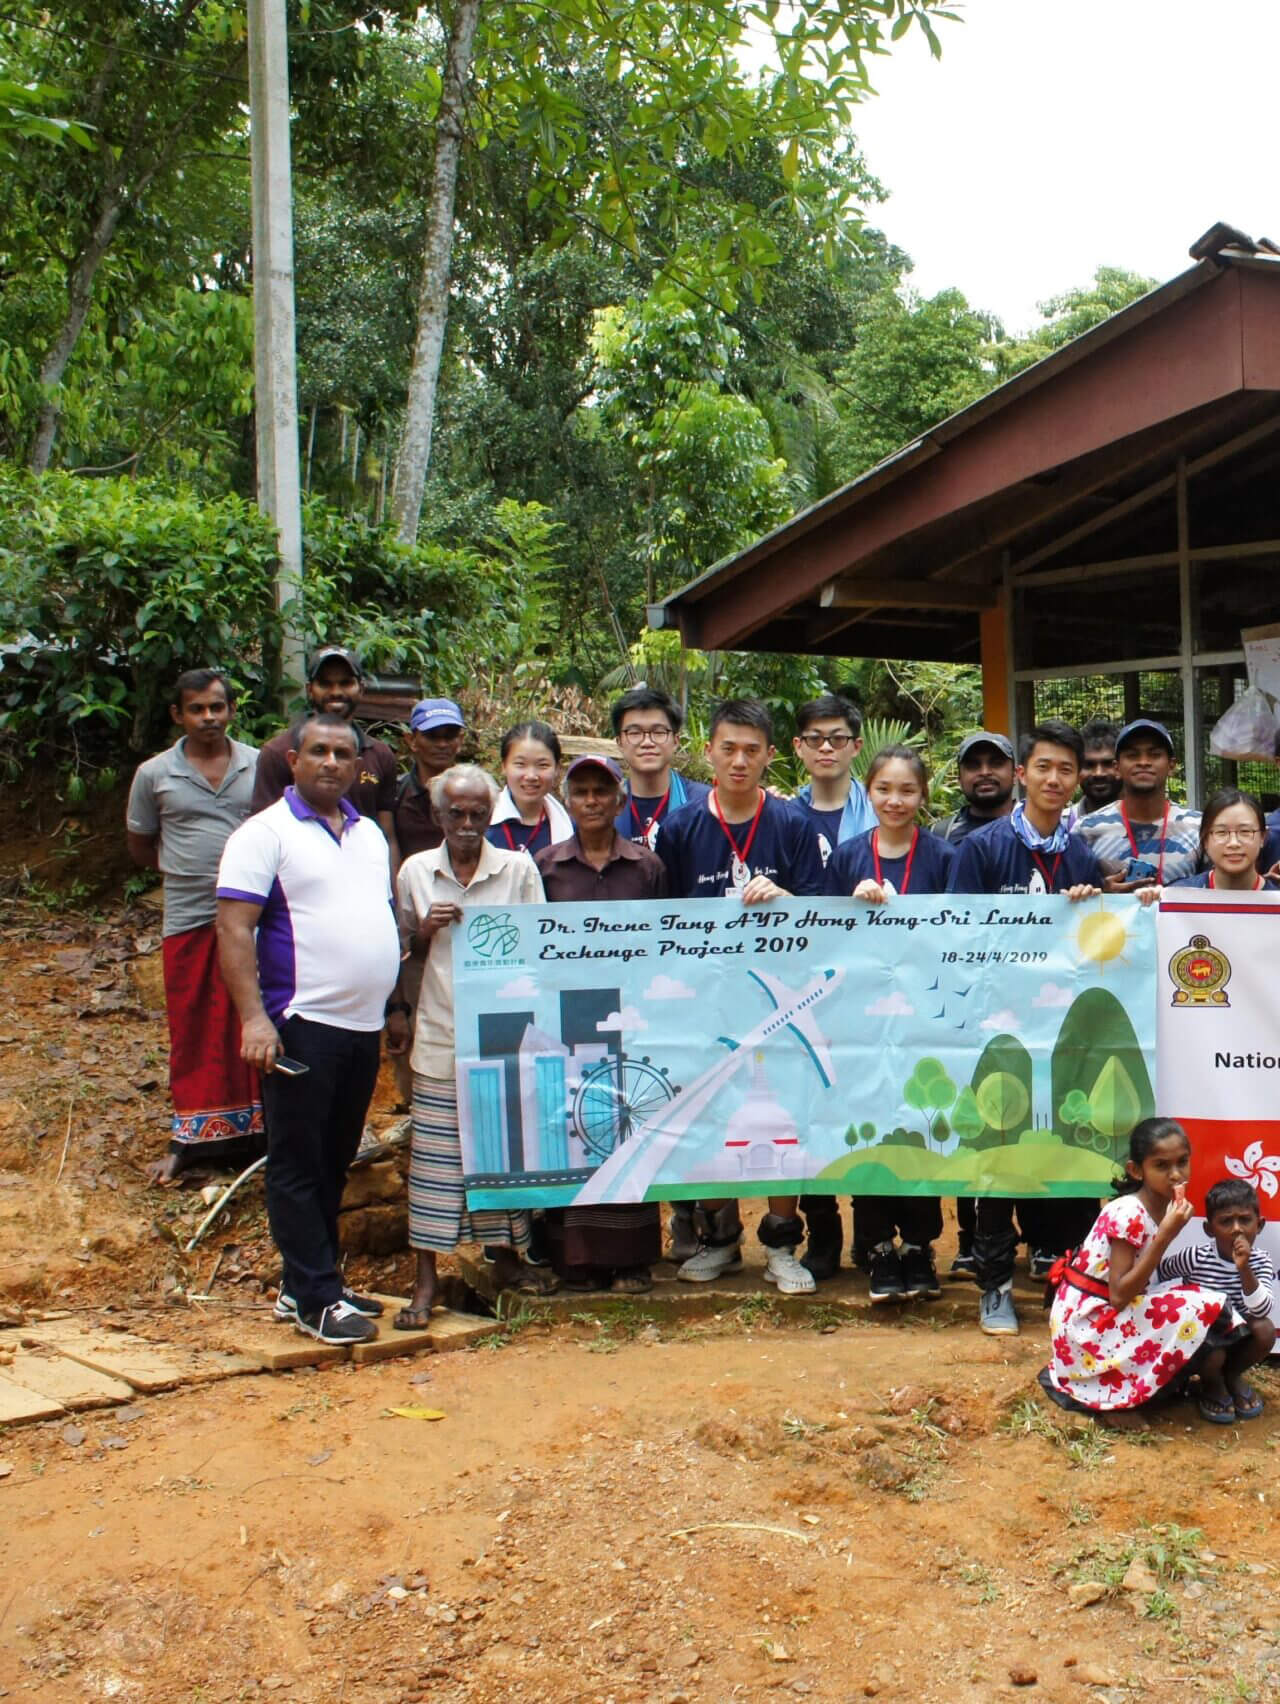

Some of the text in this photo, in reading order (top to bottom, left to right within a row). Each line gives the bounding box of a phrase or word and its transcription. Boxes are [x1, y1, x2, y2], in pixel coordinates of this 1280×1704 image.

[538, 909, 1052, 934] Dr. Irene Tang AYP Hong Kong-Sri Lanka
[539, 937, 809, 962] Exchange Project 2019
[942, 952, 1047, 963] 18-24/4/2019
